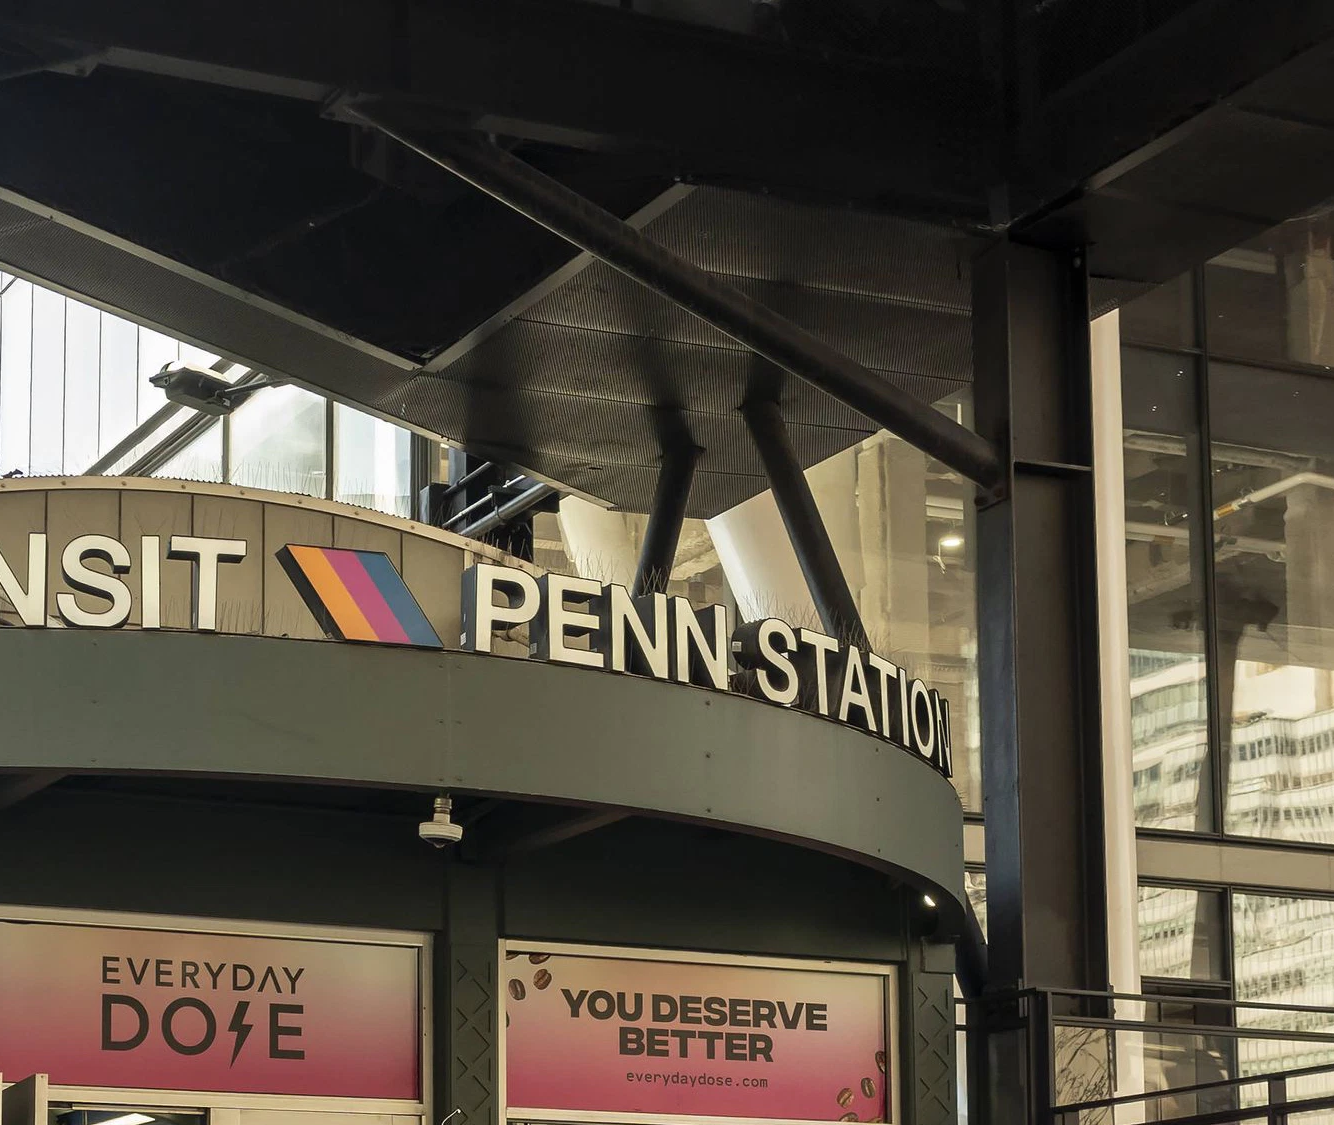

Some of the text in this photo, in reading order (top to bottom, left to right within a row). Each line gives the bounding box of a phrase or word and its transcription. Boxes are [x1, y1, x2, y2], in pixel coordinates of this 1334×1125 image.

[473, 564, 729, 690] PENN
[755, 617, 954, 778] STATION
[101, 955, 305, 995] EVERYDAY
[560, 988, 828, 1031] YOU DESERVE
[618, 1026, 775, 1063] BETTER
[625, 1069, 768, 1089] everydaydose.com
